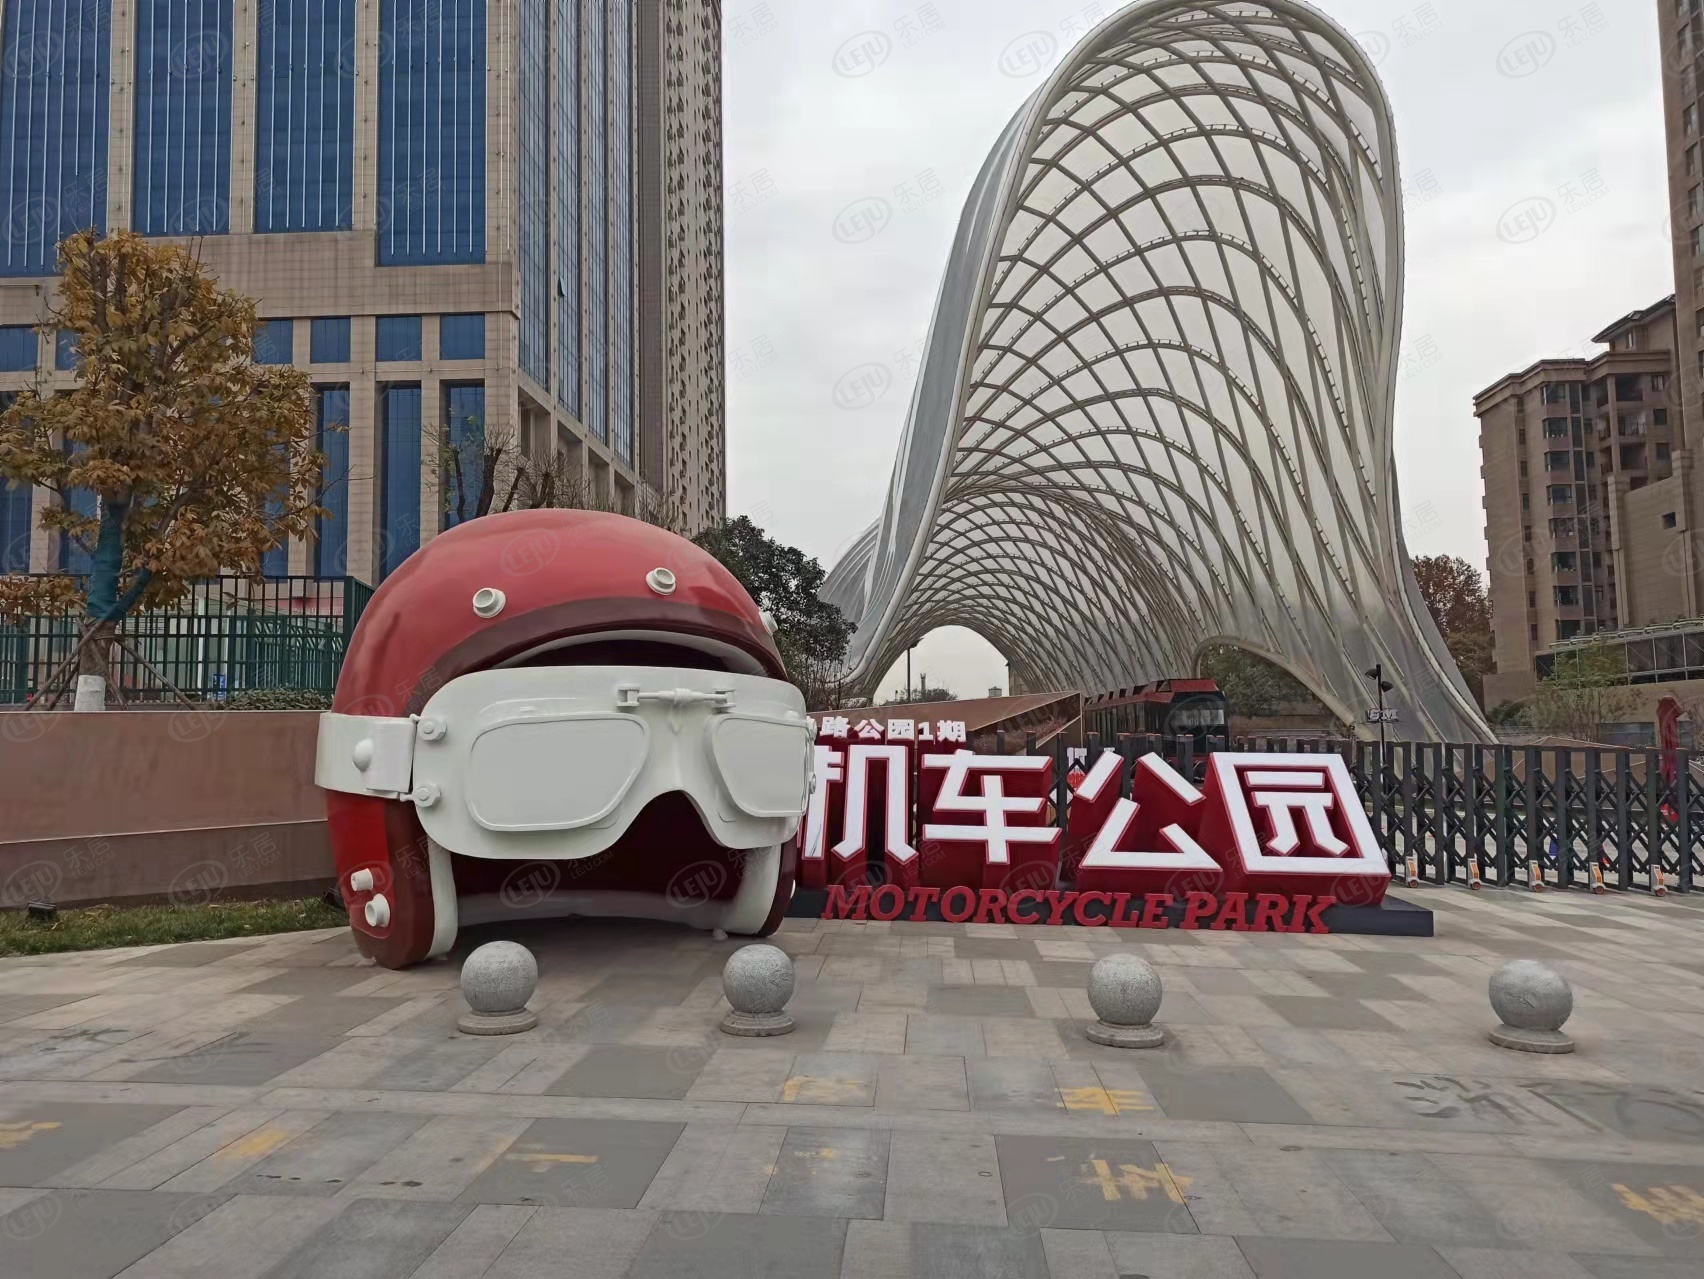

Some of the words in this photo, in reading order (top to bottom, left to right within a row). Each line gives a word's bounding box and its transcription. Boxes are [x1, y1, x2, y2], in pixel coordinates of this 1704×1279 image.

[806, 715, 967, 743] 路公园1期
[801, 744, 1392, 877] 机车公园
[820, 884, 1171, 929] MOTORCYCLE
[1179, 890, 1337, 934] PARK
